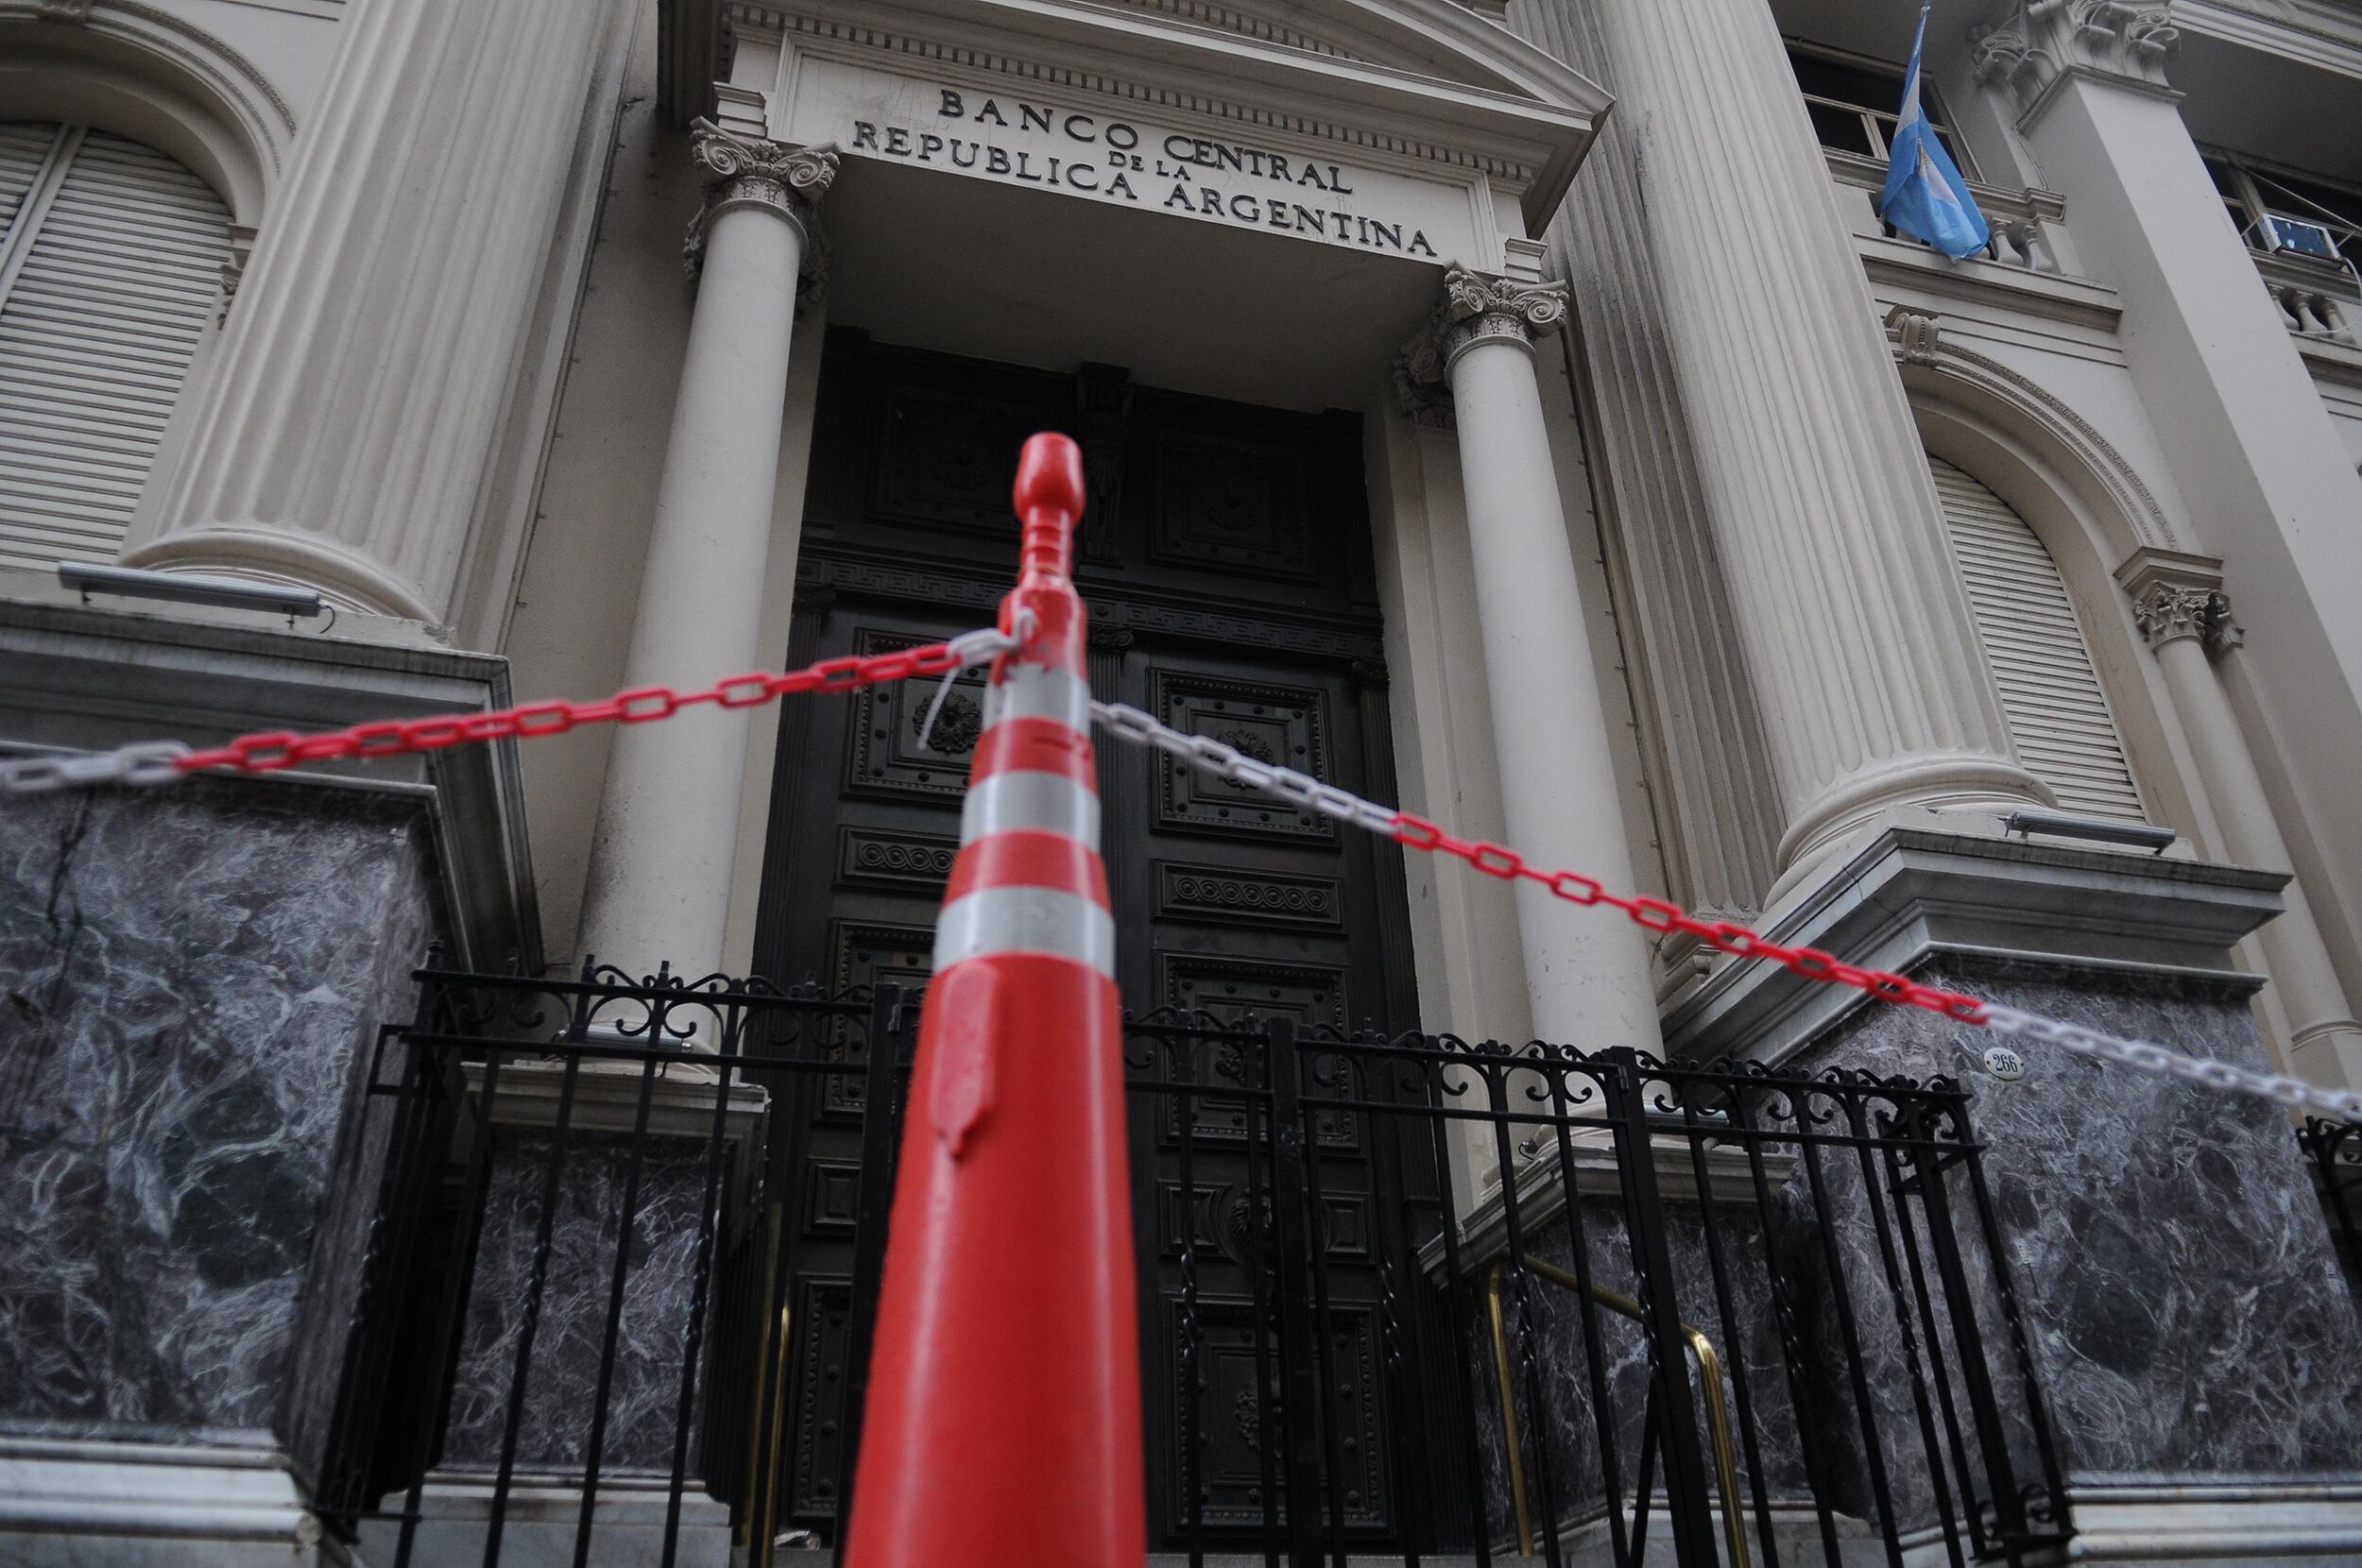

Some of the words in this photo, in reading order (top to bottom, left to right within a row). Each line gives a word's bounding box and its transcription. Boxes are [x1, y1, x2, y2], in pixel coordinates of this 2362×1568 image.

[938, 89, 1138, 149] BANCO
[1163, 134, 1353, 195] CENTRAL
[1108, 150, 1144, 172] DE
[1156, 160, 1191, 181] LA
[852, 120, 1138, 200] REPUBLICA
[1164, 183, 1438, 257] ARGENTINA
[1993, 1053, 2018, 1073] 266
